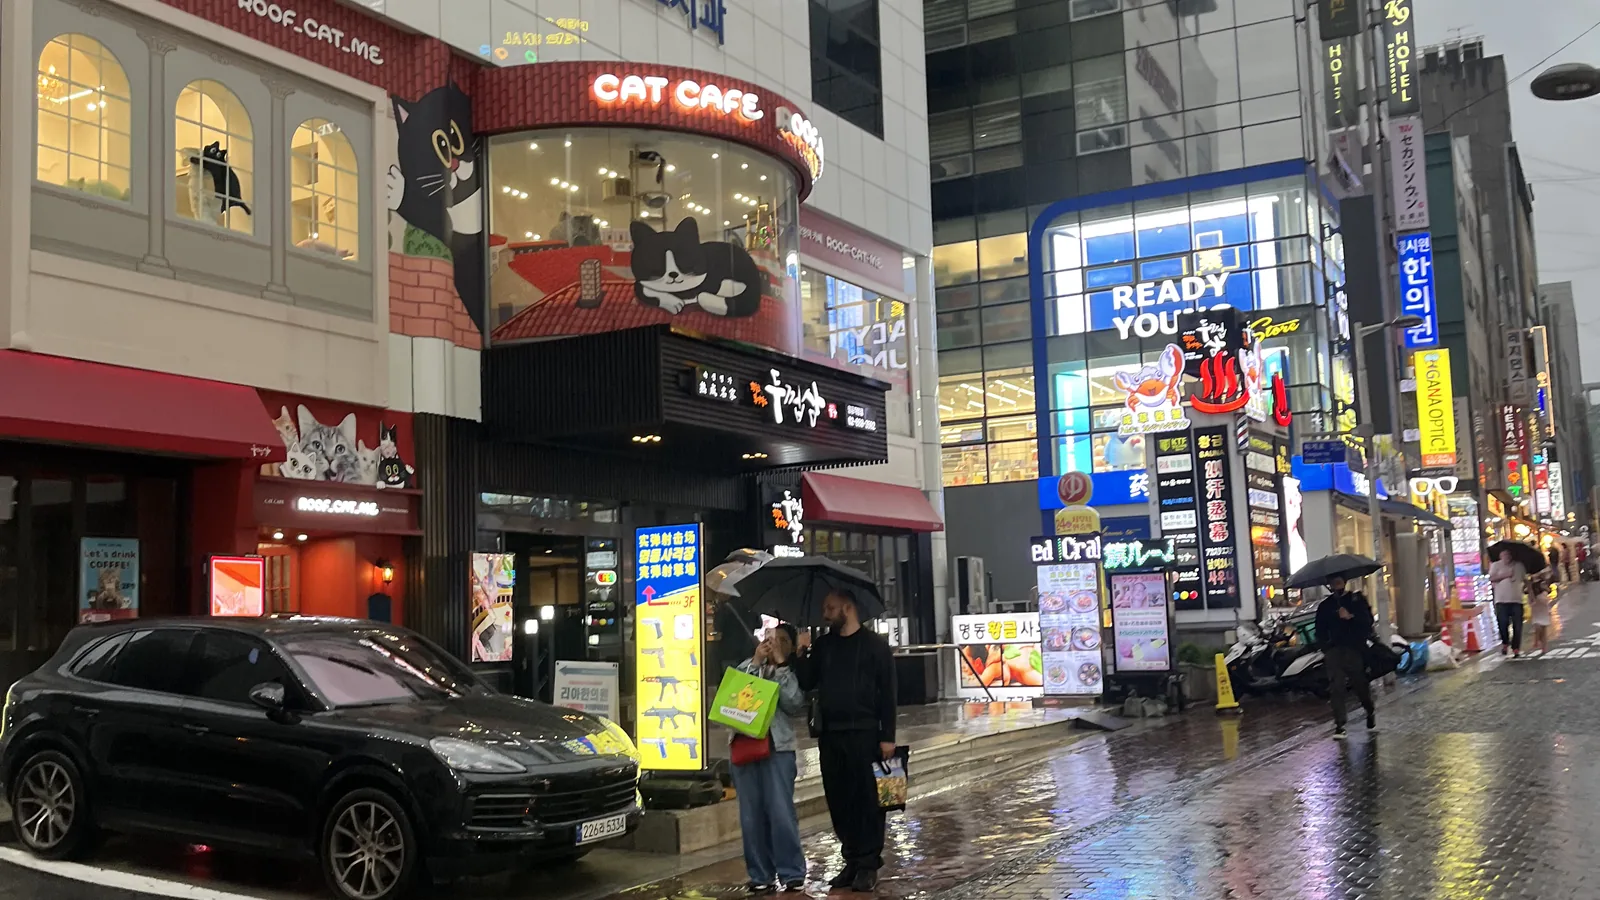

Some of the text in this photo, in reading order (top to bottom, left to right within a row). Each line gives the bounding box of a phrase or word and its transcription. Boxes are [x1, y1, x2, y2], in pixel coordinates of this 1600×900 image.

[1395, 31, 1411, 102] HOTEL
[594, 73, 764, 120] CAT CAFE
[1112, 272, 1230, 310] READY
[1403, 256, 1434, 344] 한의원
[1112, 303, 1232, 340] YOU
[1249, 316, 1300, 343] Store
[1428, 409, 1446, 447] OPTIC
[1504, 405, 1516, 439] HERA
[1198, 434, 1223, 448] 황금
[84, 549, 136, 558] Let's drink
[683, 595, 696, 609] 3F
